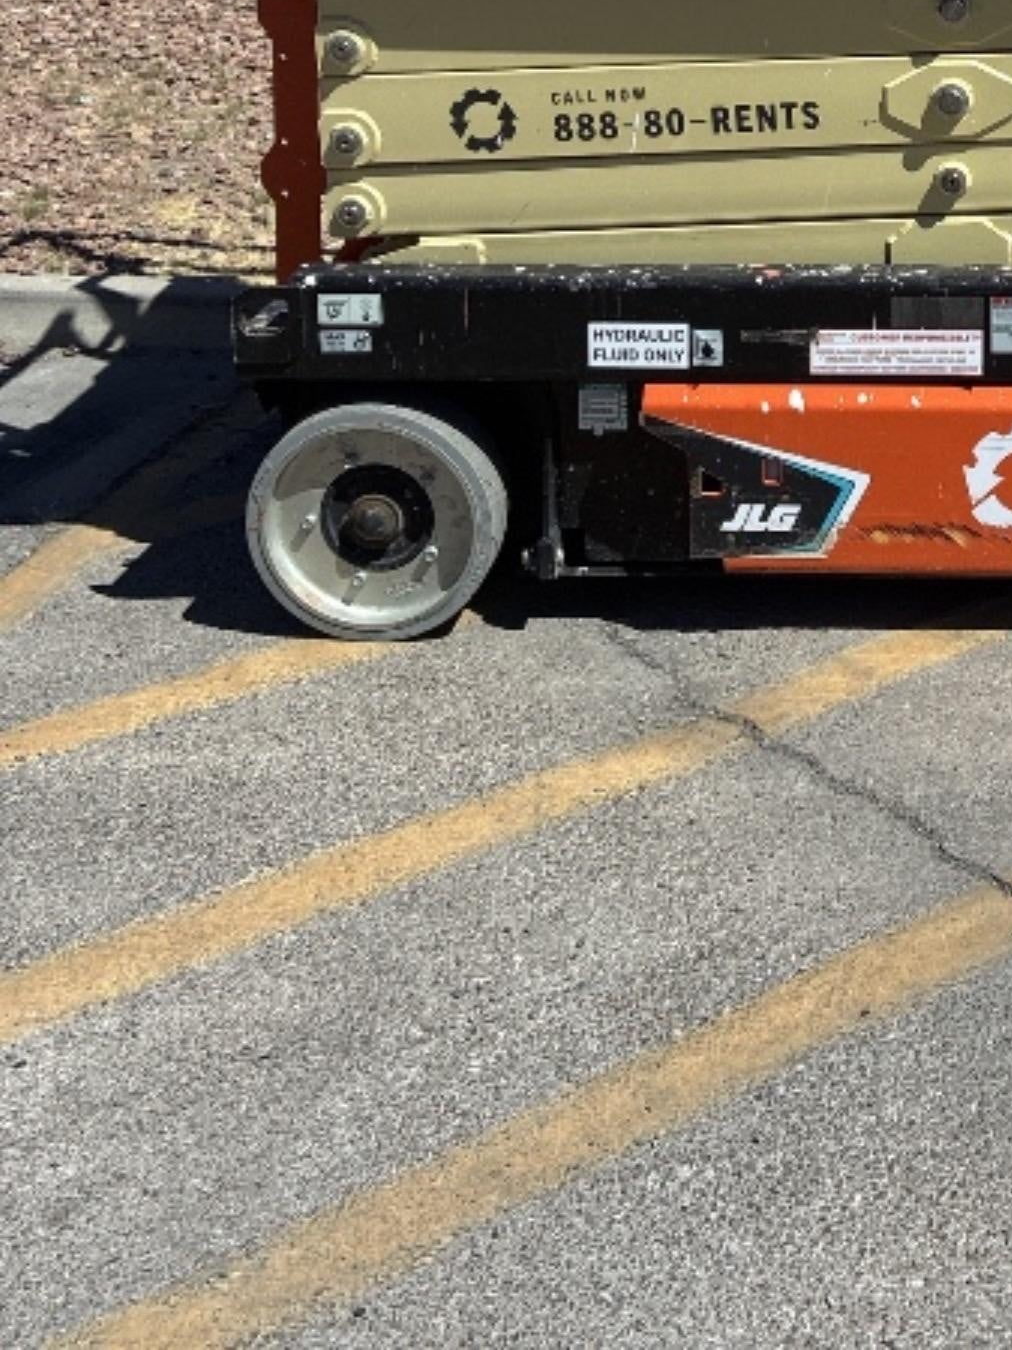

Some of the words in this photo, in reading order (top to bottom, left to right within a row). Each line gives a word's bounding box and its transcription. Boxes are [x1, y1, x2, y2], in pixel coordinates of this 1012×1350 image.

[551, 89, 597, 106] CALL
[605, 86, 646, 103] NOW
[593, 329, 686, 343] HYDRAULIC
[593, 347, 641, 362] FLUID
[643, 348, 685, 363] ONLY
[719, 503, 802, 533] JLG
